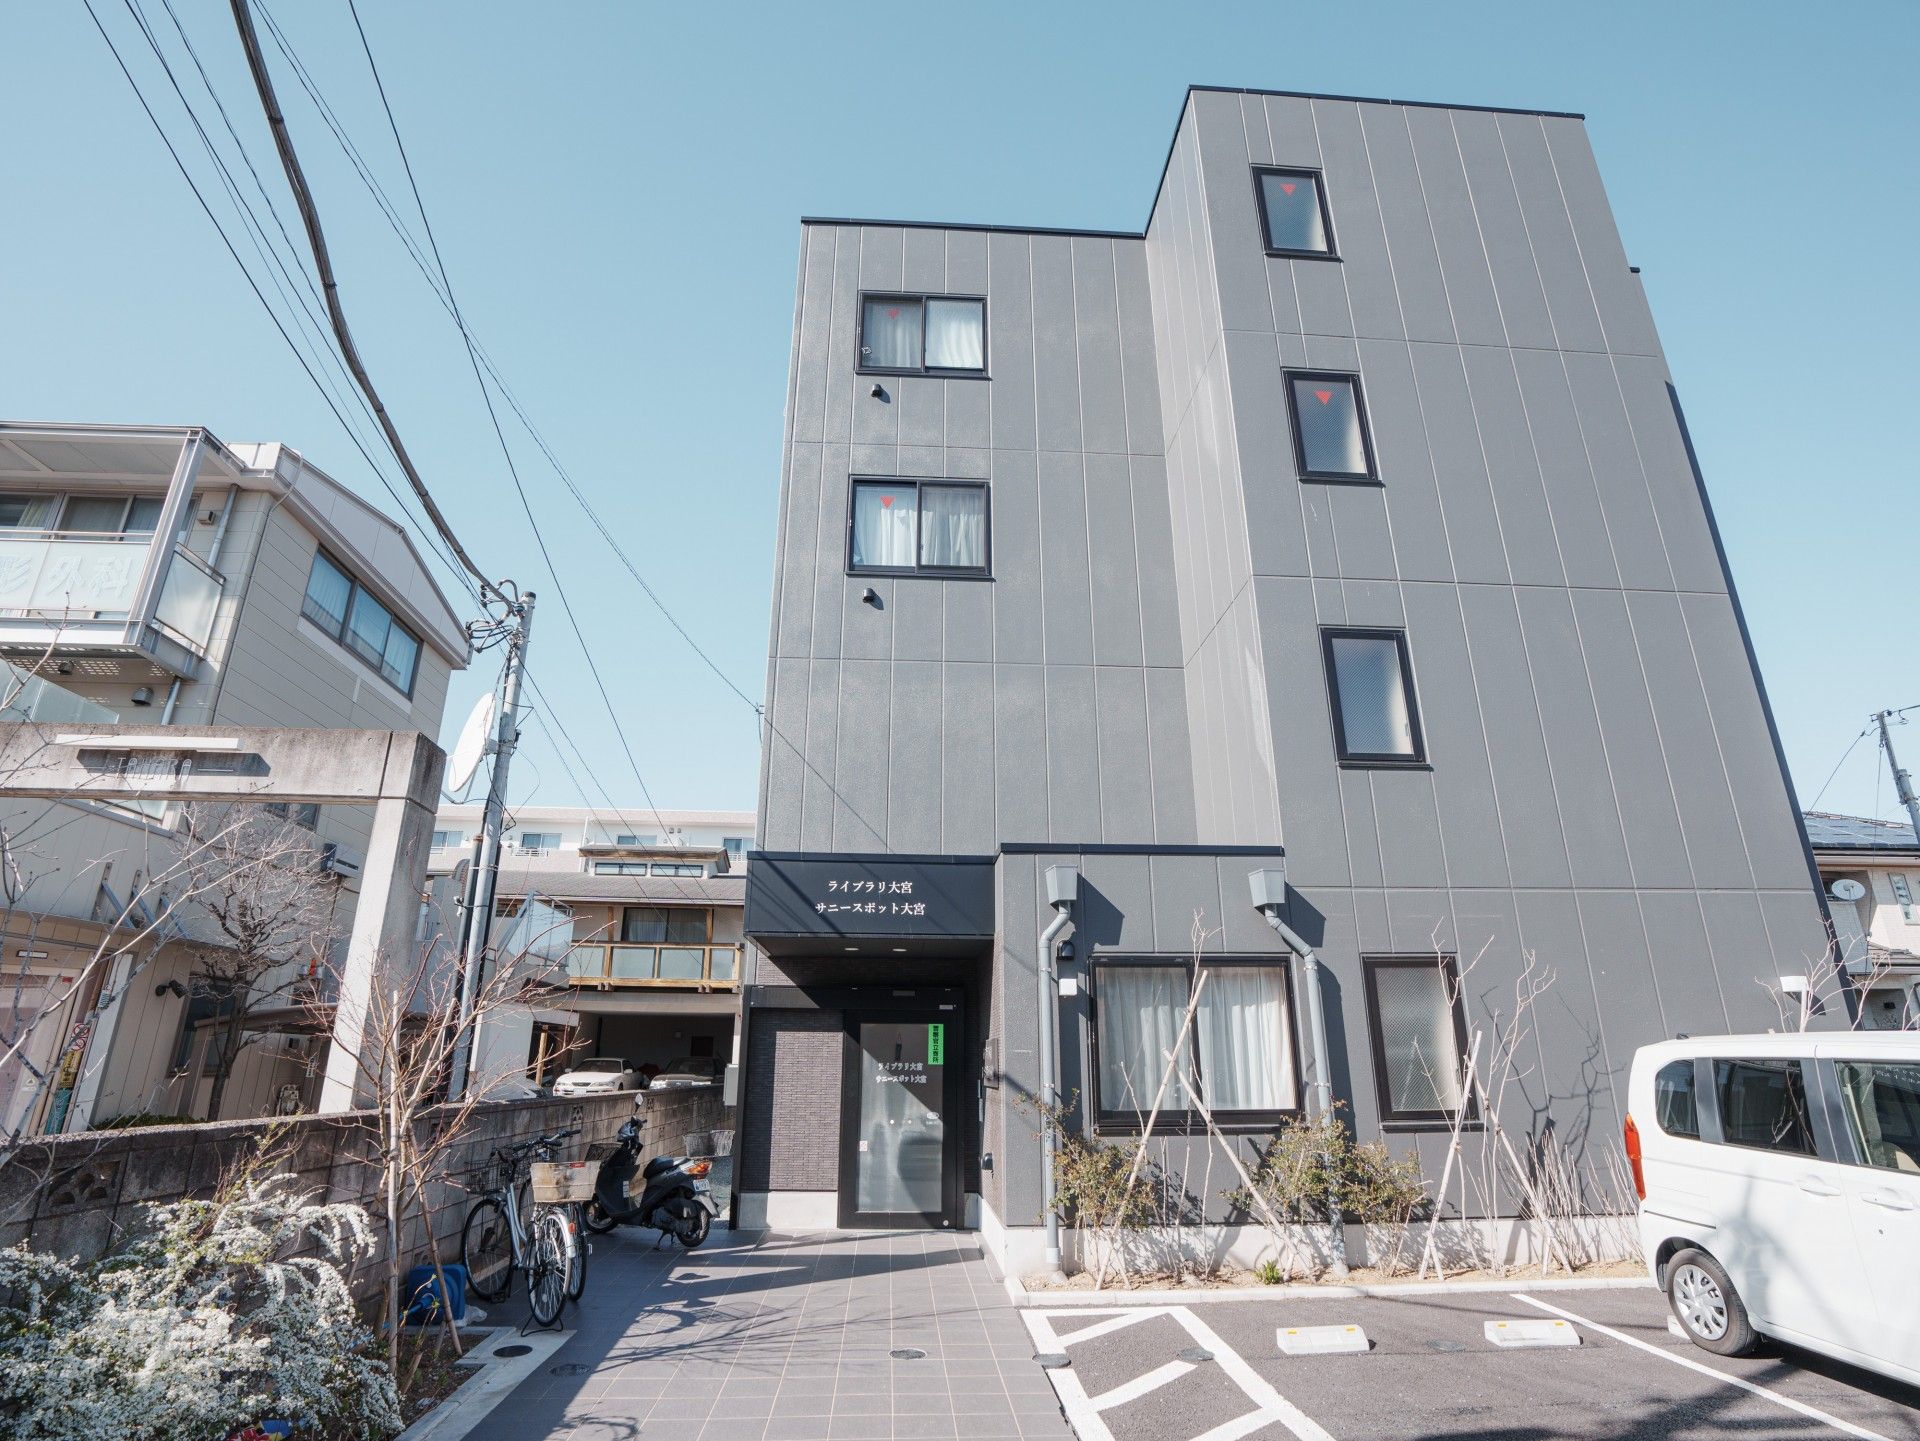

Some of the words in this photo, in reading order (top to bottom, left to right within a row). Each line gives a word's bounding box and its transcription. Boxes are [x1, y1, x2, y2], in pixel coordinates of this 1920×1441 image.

[827, 880, 913, 894] ライブラリ大宮
[814, 902, 926, 916] サニースポット大宮
